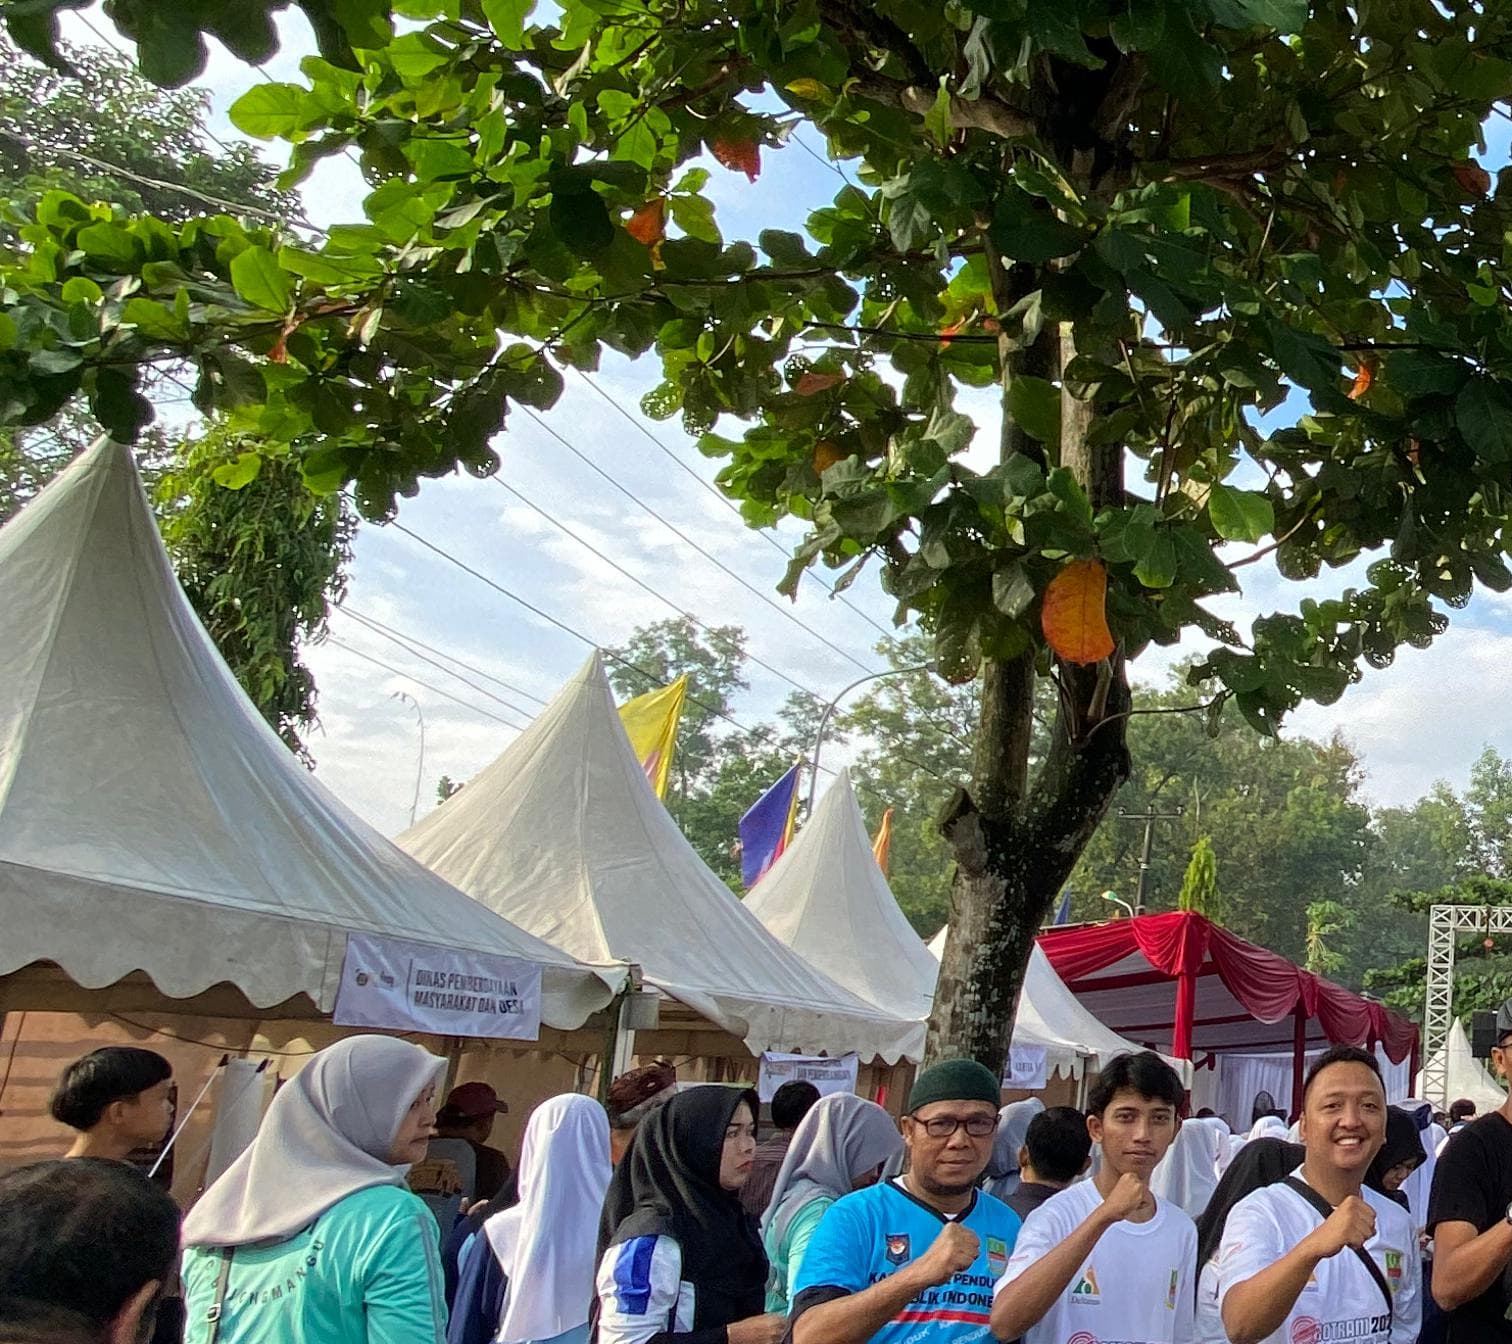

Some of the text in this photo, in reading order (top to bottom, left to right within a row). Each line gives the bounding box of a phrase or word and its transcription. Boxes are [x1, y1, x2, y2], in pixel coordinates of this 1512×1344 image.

[416, 969, 446, 989] DINAS
[414, 991, 524, 1015] MASYARAKAT DAN DESA
